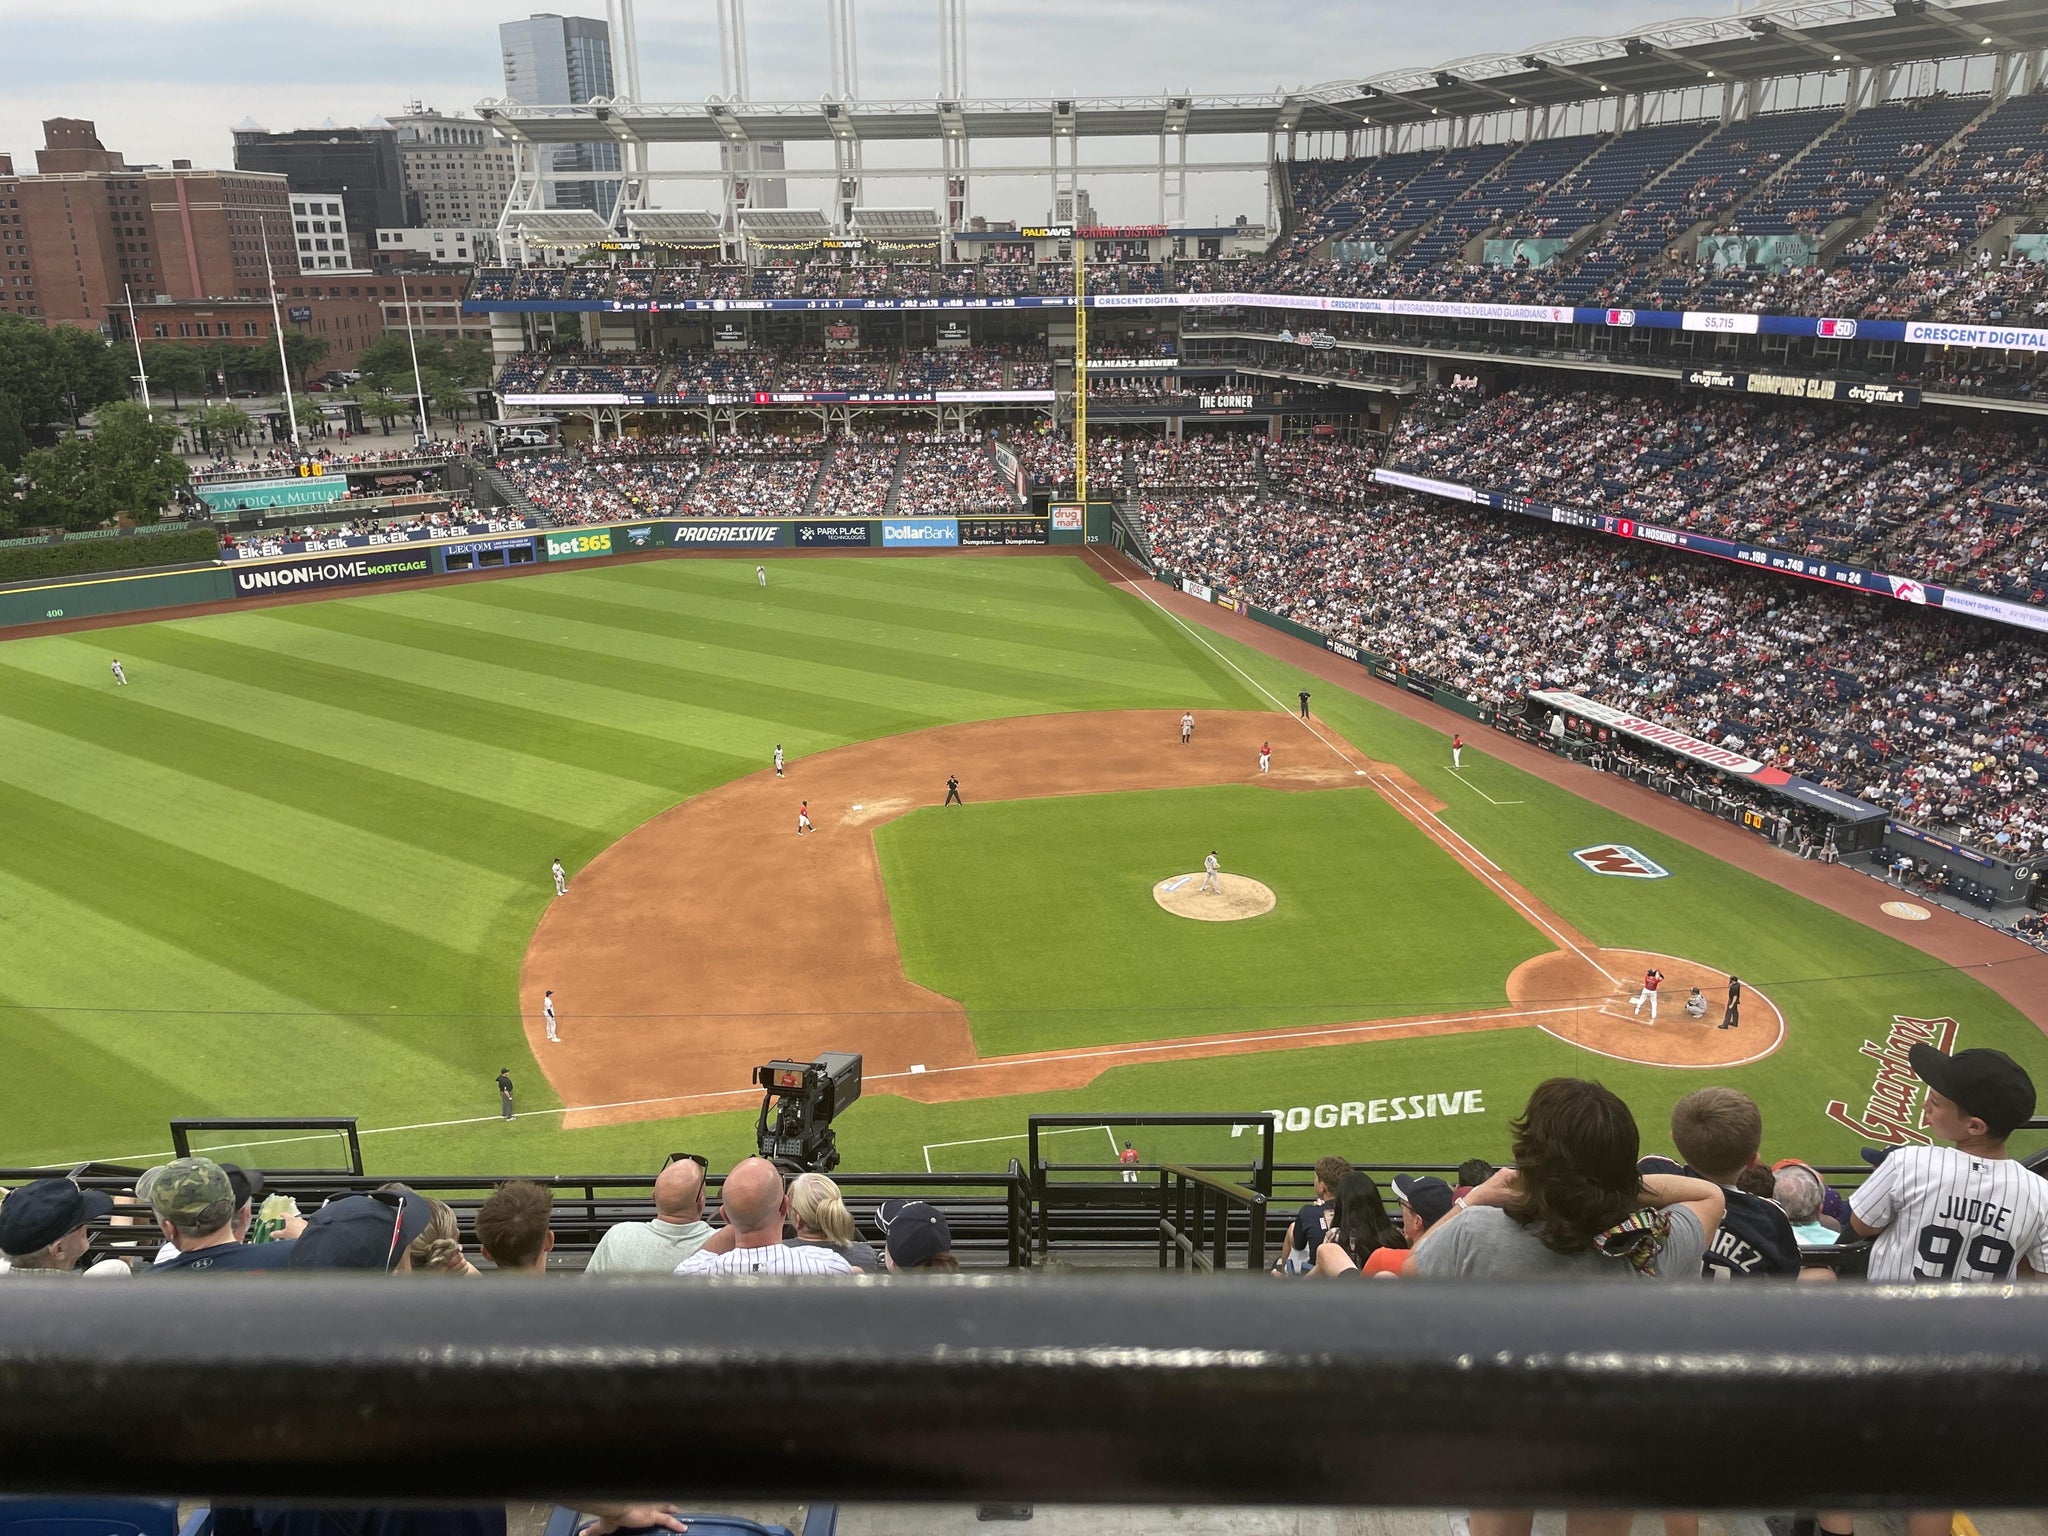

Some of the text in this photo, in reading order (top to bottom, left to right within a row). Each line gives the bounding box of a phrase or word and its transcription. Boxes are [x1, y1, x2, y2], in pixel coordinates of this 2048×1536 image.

[1075, 224, 1169, 238] PENNANT DISTRICT
[1099, 296, 1179, 305] CRESCENT DIGITAL
[1189, 296, 1200, 304] AV
[1331, 300, 1382, 310] CRESCENT DIGITAL
[1398, 303, 1435, 314] INTEGRATOR
[1436, 305, 1449, 314] FOR
[1450, 305, 1462, 315] THE
[1463, 305, 1502, 317] CLEVELAND
[1504, 308, 1547, 319] GUARDIANS
[1704, 316, 1734, 329] $5,715
[1913, 327, 2046, 347] CRESCENT DIGITAL
[1104, 360, 1136, 368] HEAD'S
[1138, 358, 1179, 368] BREWERY
[1690, 372, 1734, 388] drug mart
[1747, 374, 1836, 400] CHAMPIONS CLUB
[1199, 395, 1253, 408] THE CORNER
[1848, 386, 1904, 403] drug mart
[284, 478, 314, 486] Cleveland
[314, 476, 344, 484] Guardians
[224, 494, 282, 509] MEDICAL
[1054, 508, 1077, 522] drug
[134, 521, 190, 534] PROGRESSIVE
[674, 526, 777, 542] PROGRESSIVE
[817, 526, 866, 536] PARK PLACE
[884, 526, 954, 540] DollarBank
[1622, 522, 1628, 533] 8
[1645, 527, 1677, 544] HOSKINS
[0, 536, 50, 548] ROGRESSIVE
[63, 528, 121, 542] PROGRESSIVE
[448, 542, 492, 555] LECOM
[547, 534, 611, 556] bet365
[368, 560, 427, 576] MORTGAGE
[1784, 558, 1803, 572] .749
[1819, 566, 1826, 577] 6
[1848, 572, 1862, 584] 24
[1946, 596, 2002, 614] CRESCENT DIGITAL
[46, 609, 64, 618] 400
[1614, 718, 1748, 767] GUARDIANS
[1825, 1015, 1959, 1147] Guardians
[1939, 1195, 2012, 1232] JUDGE
[1913, 1223, 2016, 1284] 99
